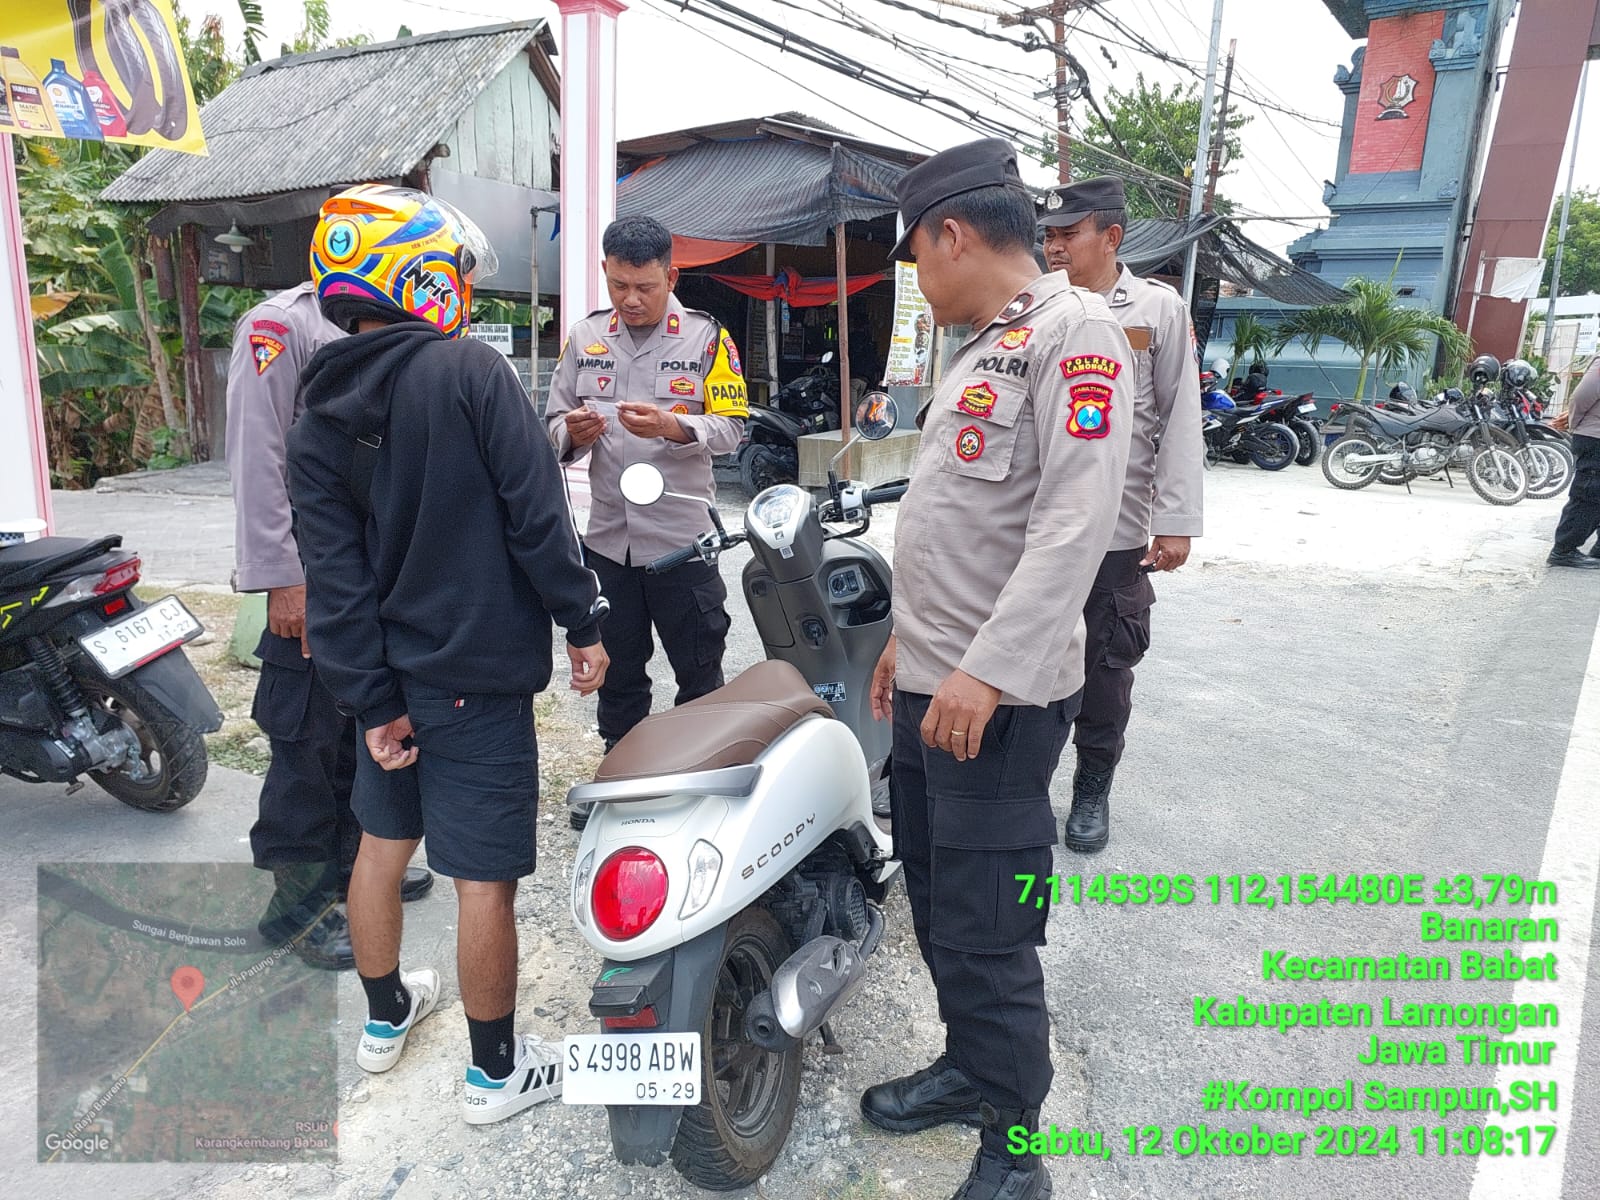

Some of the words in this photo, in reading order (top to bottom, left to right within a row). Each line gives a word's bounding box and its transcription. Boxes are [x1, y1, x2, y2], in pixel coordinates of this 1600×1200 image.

[661, 361, 702, 373] POLRI
[972, 356, 1029, 378] POLRI
[1066, 357, 1115, 368] POLRES
[1066, 364, 1115, 375] LAMONGAN
[711, 384, 748, 401] PADA
[93, 640, 108, 654] S
[114, 616, 153, 643] 6167
[159, 603, 181, 621] CJ
[620, 818, 656, 826] HONDA
[741, 813, 816, 880] SCOOPY
[569, 1044, 580, 1072] S
[587, 1042, 641, 1073] 4998
[649, 1042, 694, 1072] ABW
